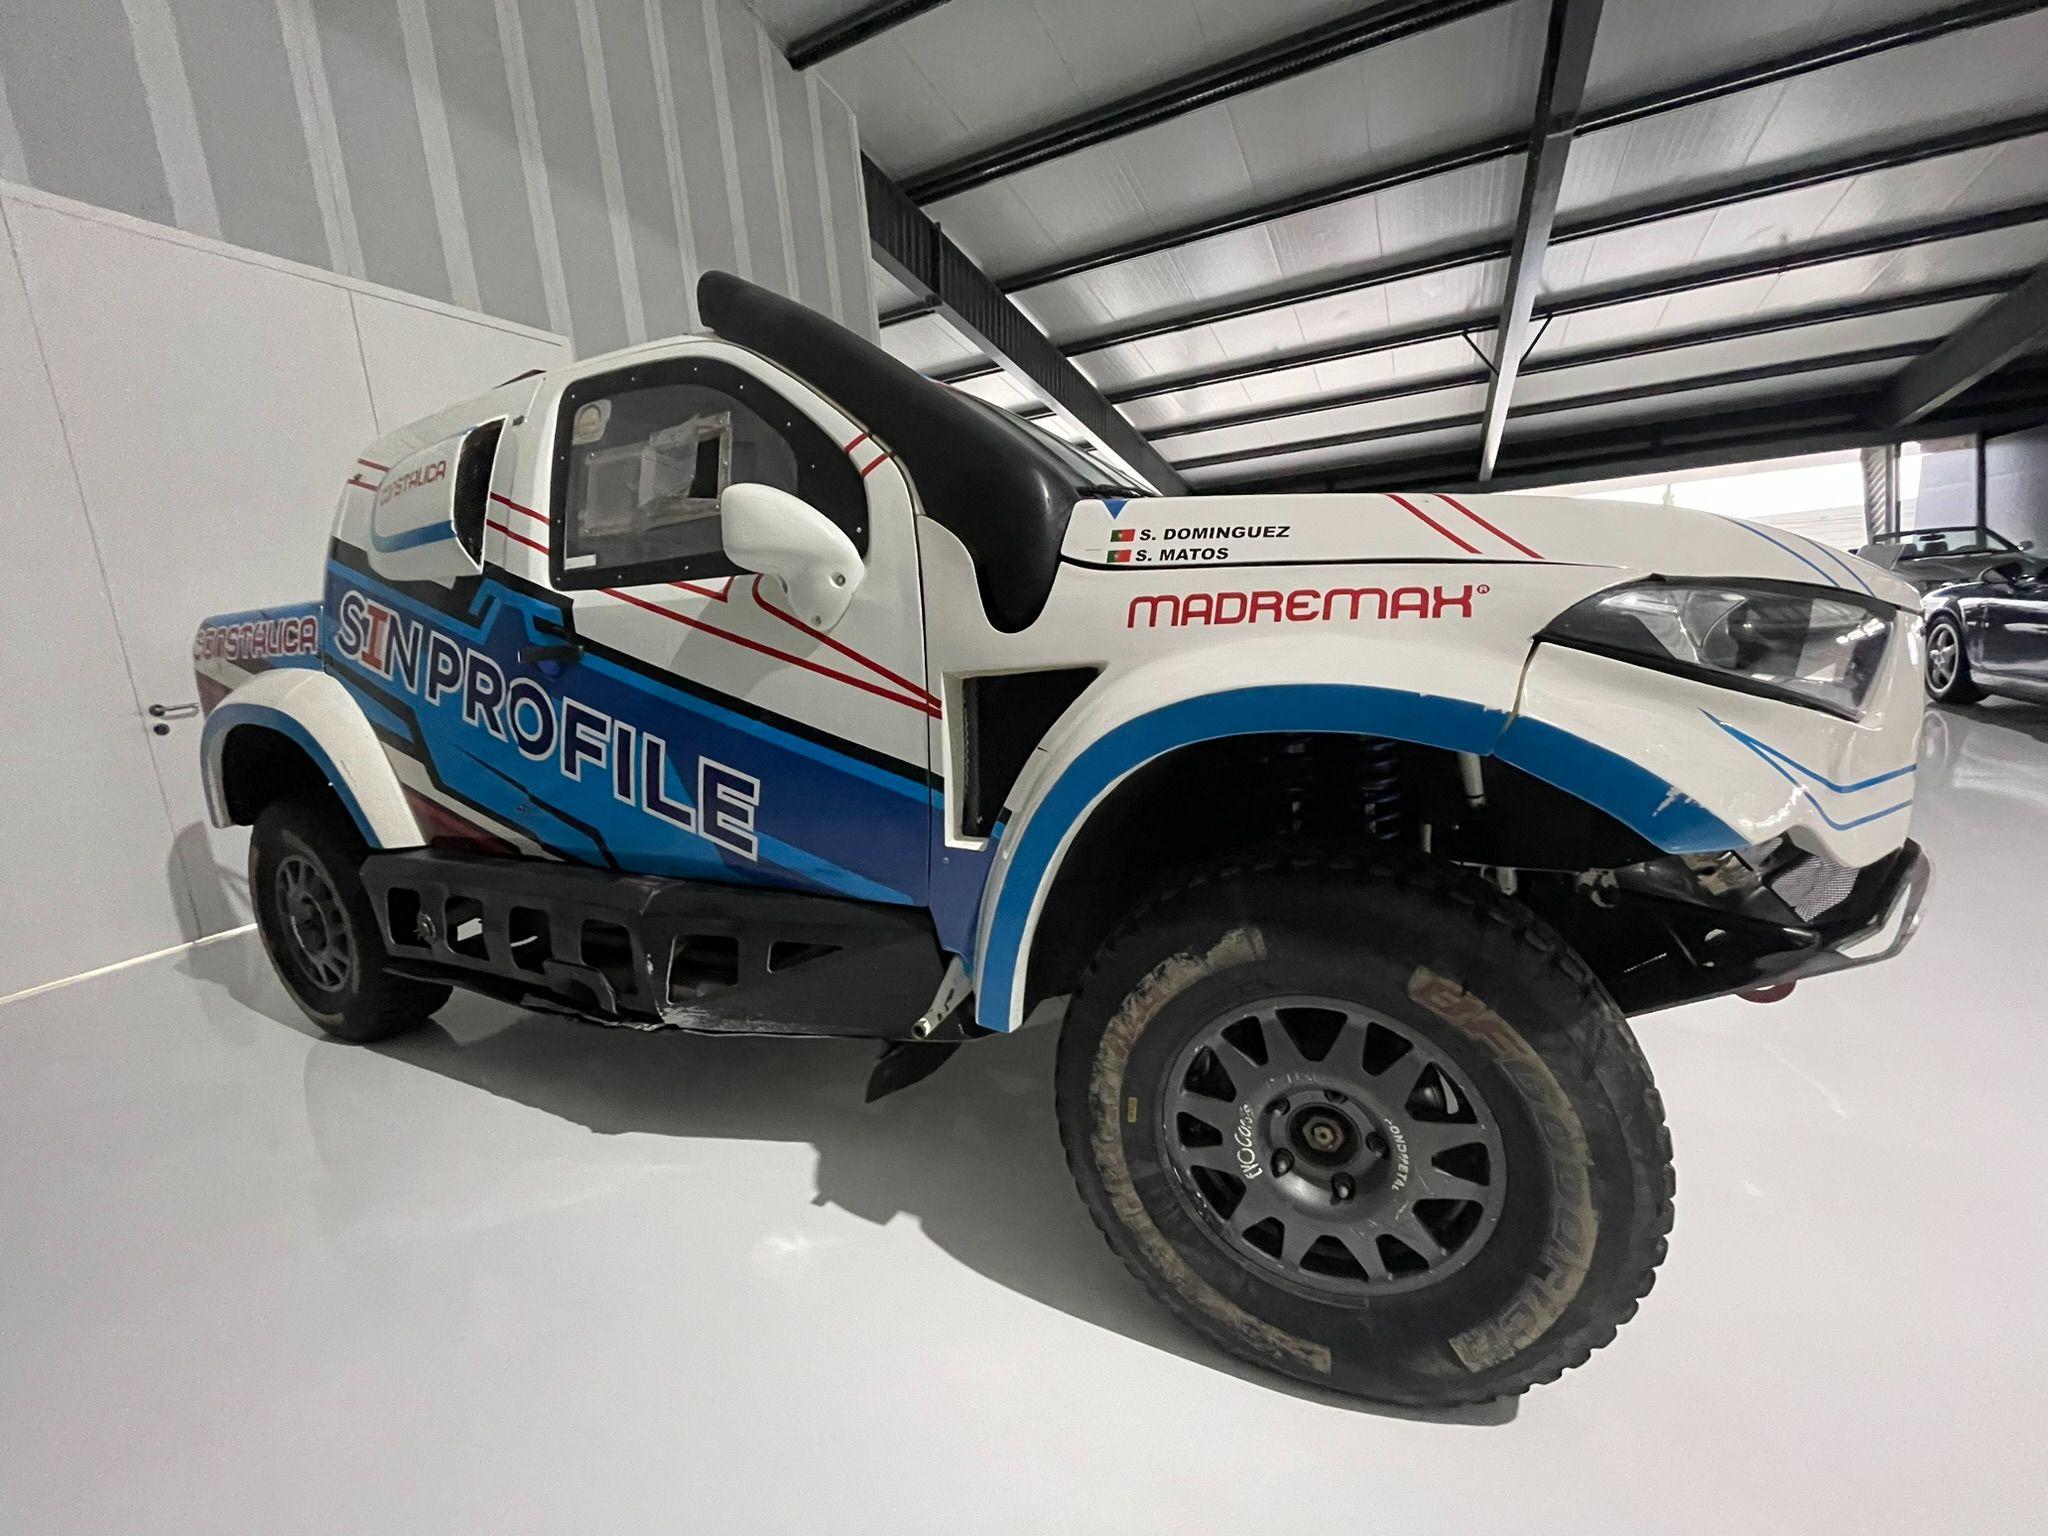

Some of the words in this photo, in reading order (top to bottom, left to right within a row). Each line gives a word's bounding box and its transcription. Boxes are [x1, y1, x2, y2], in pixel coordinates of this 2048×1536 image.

[1139, 528, 1157, 542] S.
[1163, 526, 1291, 541] DOMINGUEZ
[1135, 549, 1152, 562] S.
[1159, 547, 1229, 562] MATOS
